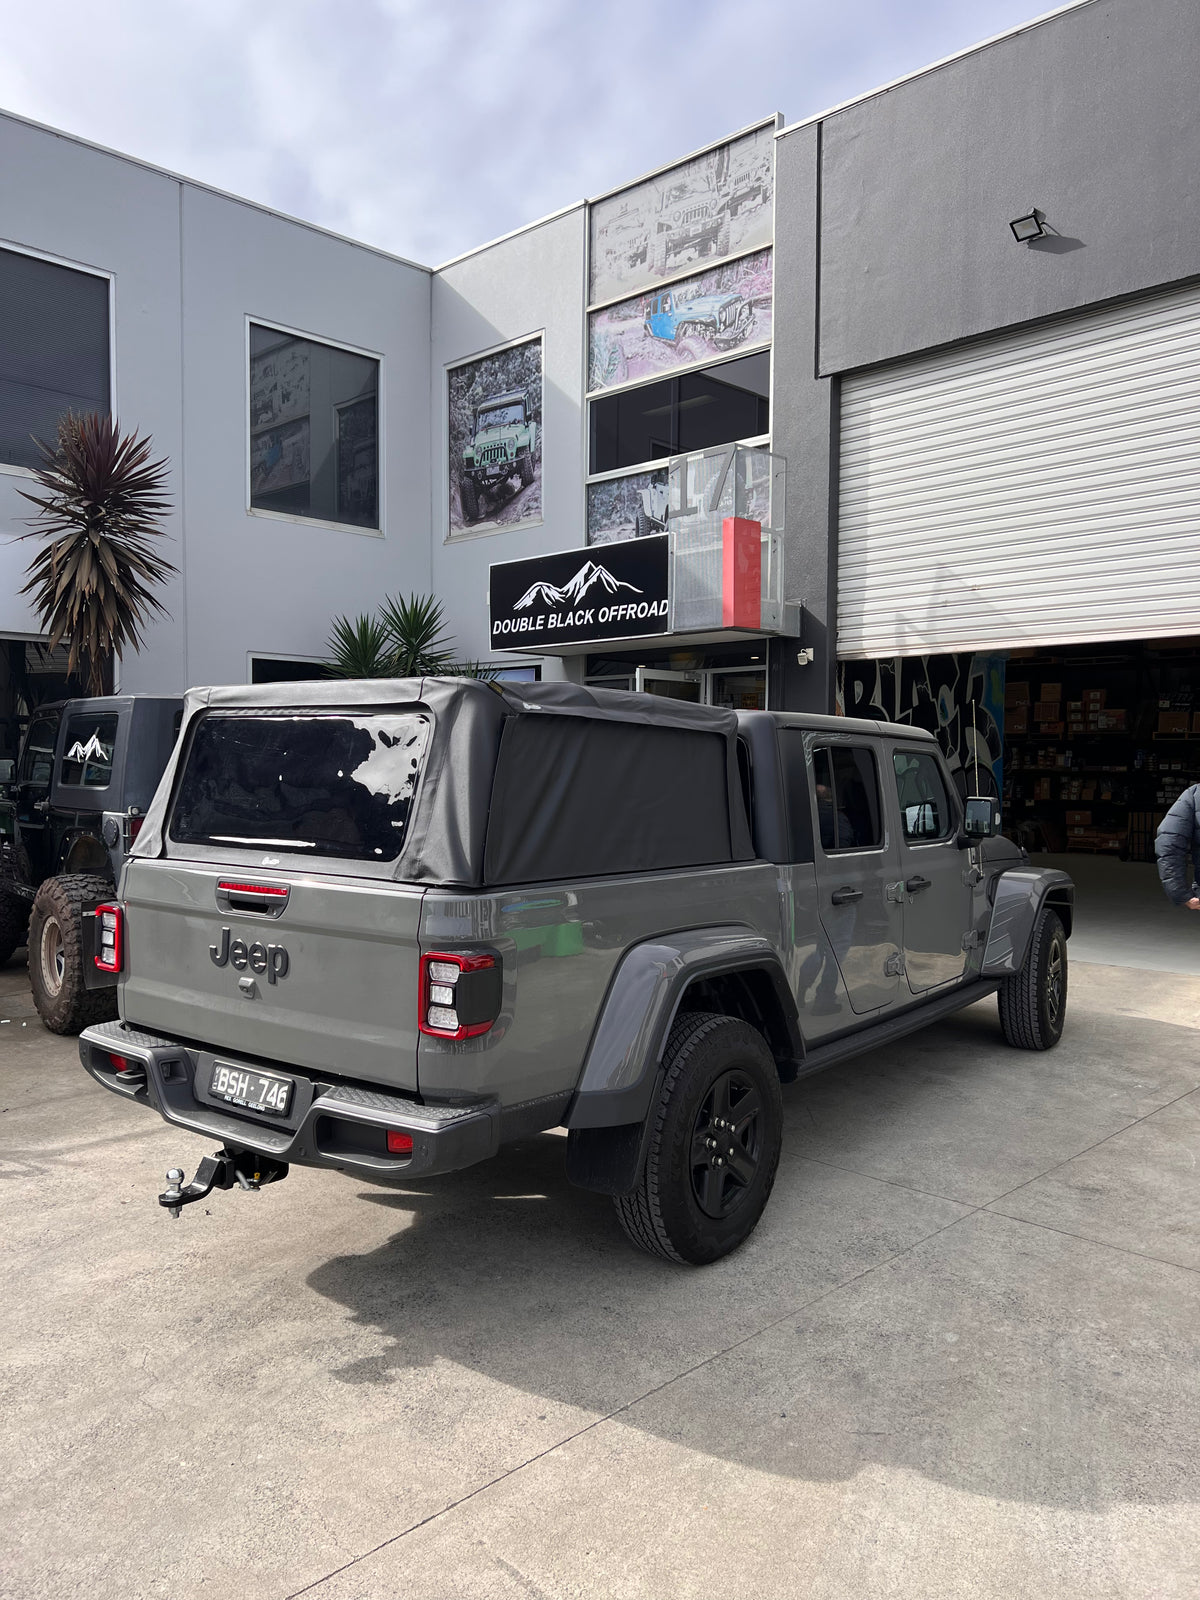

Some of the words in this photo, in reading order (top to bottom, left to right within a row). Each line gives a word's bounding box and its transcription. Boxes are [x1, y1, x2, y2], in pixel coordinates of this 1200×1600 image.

[492, 615, 546, 635] DOUBLE
[547, 608, 596, 629] BLACK
[598, 599, 669, 623] OFFROAD
[208, 926, 290, 985] Jeep
